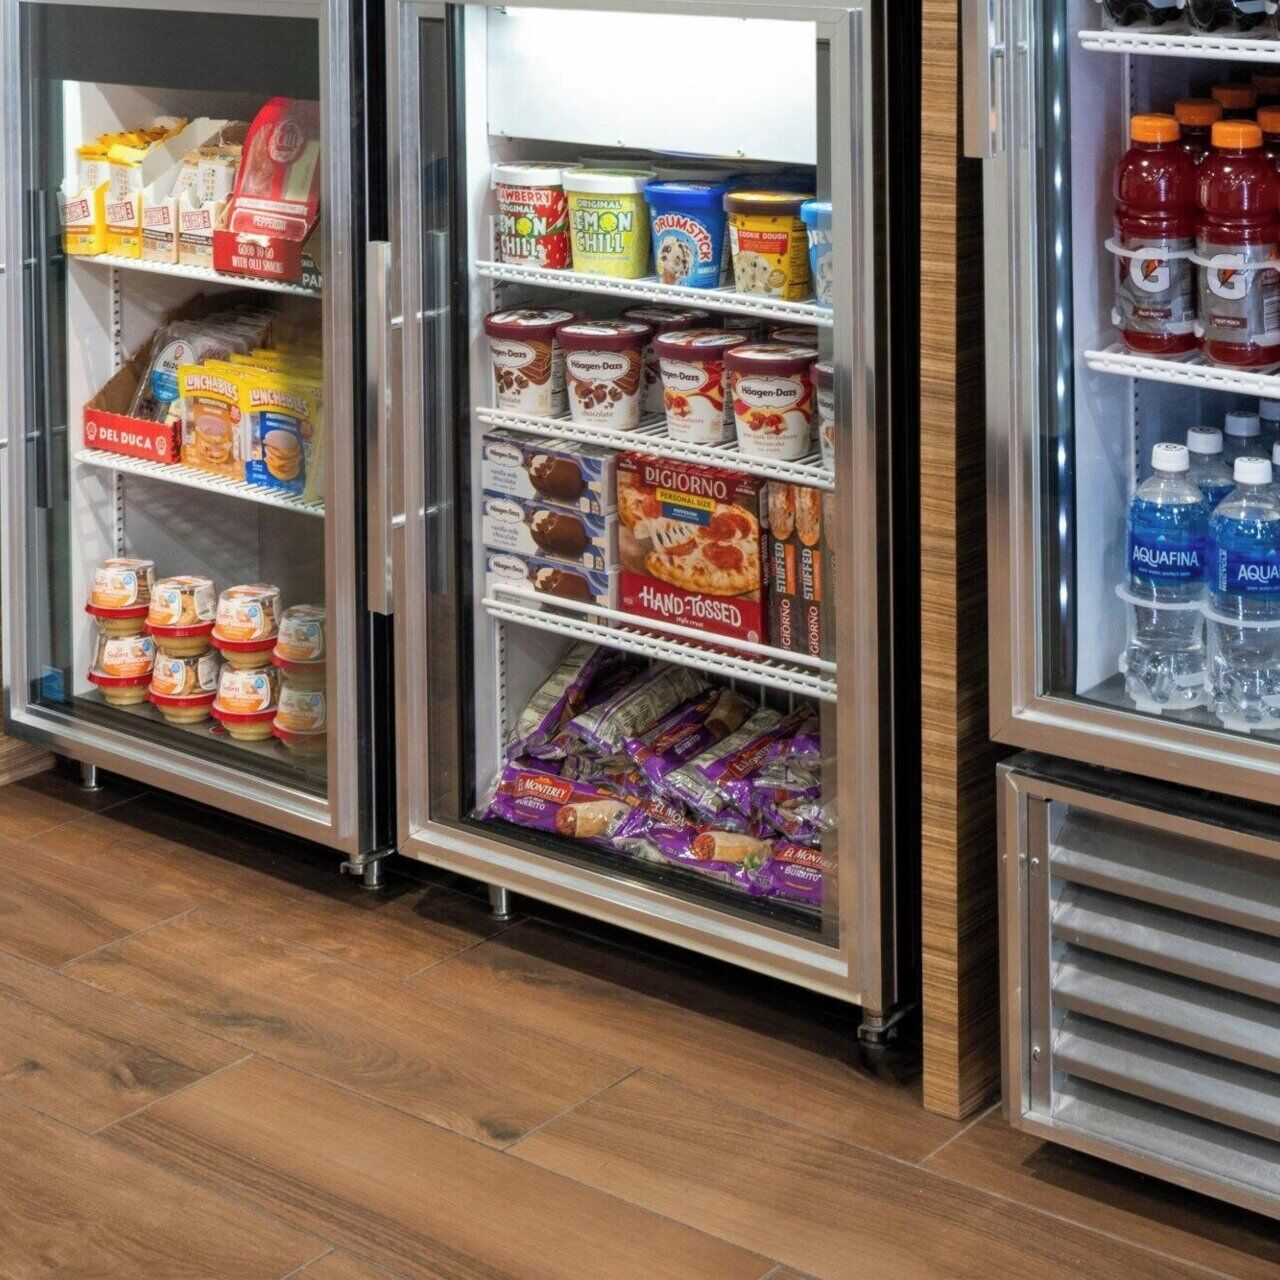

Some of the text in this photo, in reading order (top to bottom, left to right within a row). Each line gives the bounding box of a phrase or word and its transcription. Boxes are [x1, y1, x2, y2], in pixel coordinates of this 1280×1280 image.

[577, 199, 623, 209] ORIGINAL
[501, 235, 538, 257] CHILL
[577, 232, 624, 254] CHILL
[653, 215, 714, 263] DRUMSTICK
[738, 231, 788, 241] COOKIE DOUGH
[238, 243, 275, 259] GOOD TO GO
[231, 255, 284, 274] WITH SNACKS
[185, 373, 239, 406] LUNCHABLES
[250, 387, 310, 417] LUNCHABLES
[98, 428, 152, 450] DEL DUCA
[659, 490, 713, 509] PERSONAL SIZE
[1133, 544, 1200, 568] AQUAFINA
[775, 542, 787, 594] STUFFED
[802, 548, 814, 600] STUFFED
[639, 585, 742, 628] HAND-TOSSED
[523, 779, 567, 799] MONTEREY
[784, 848, 794, 857] EL
[784, 865, 819, 882] BURRITO
